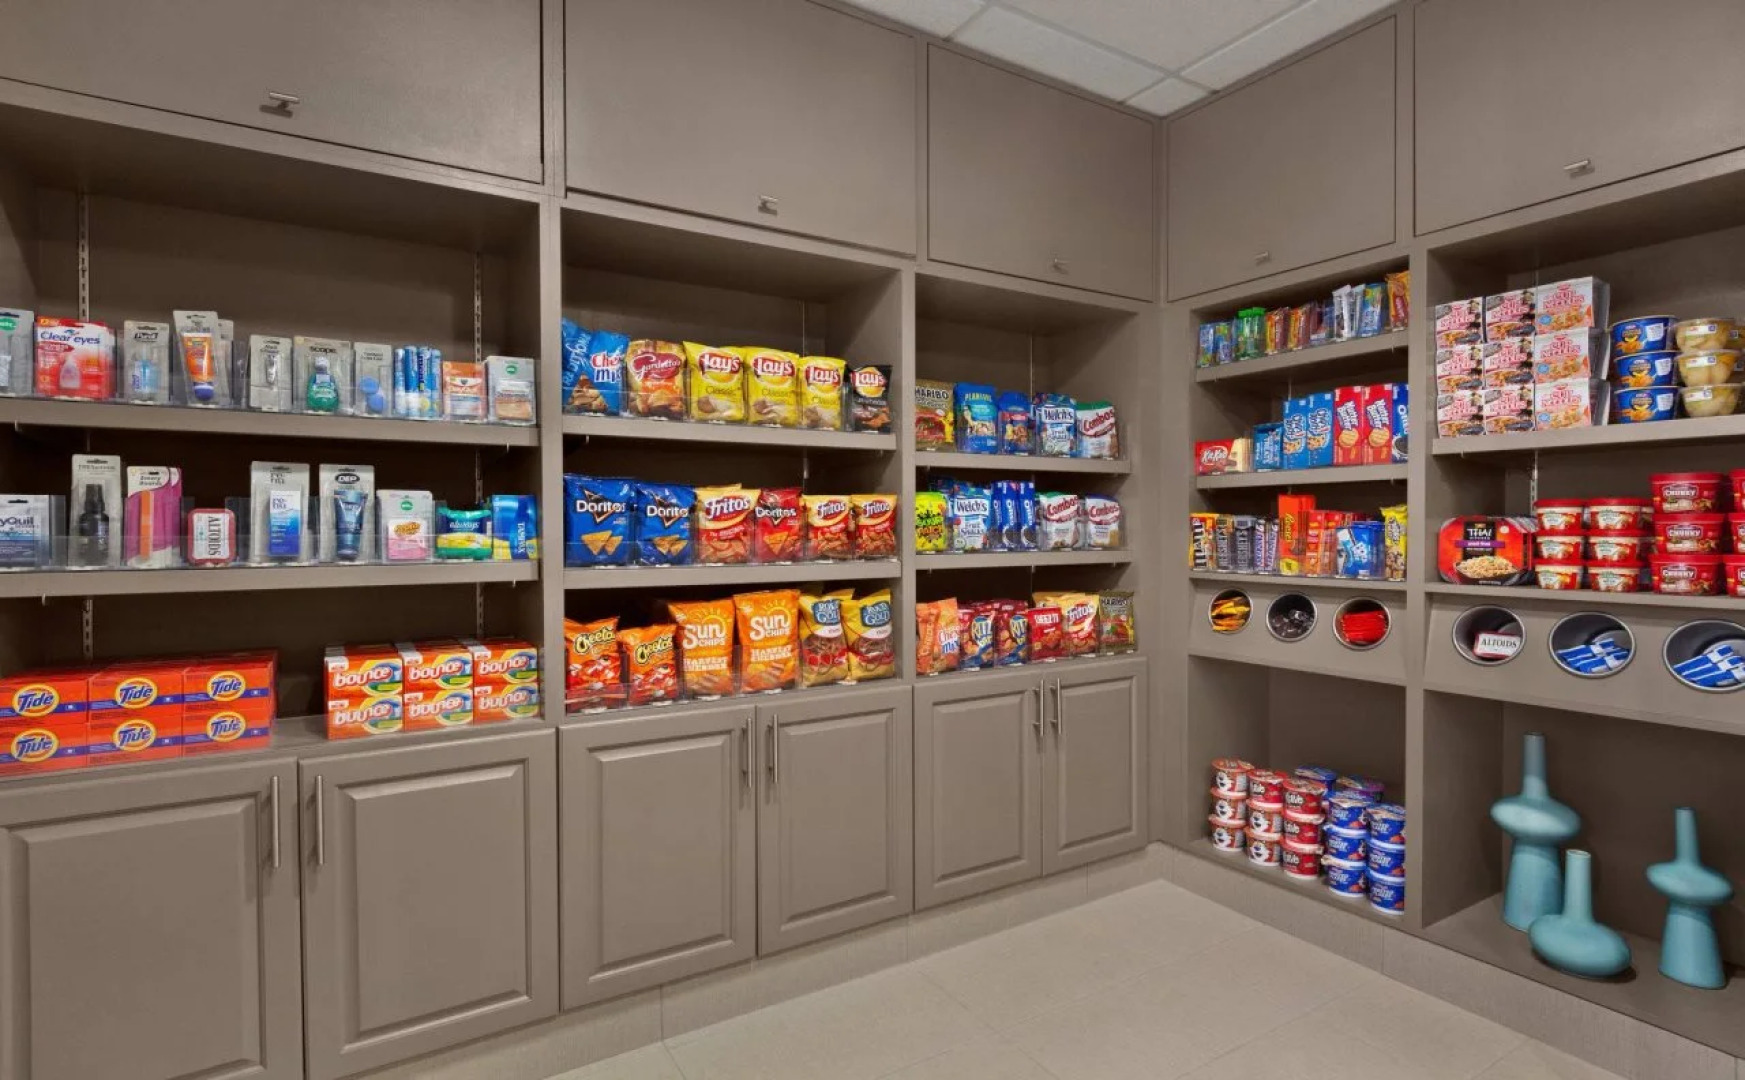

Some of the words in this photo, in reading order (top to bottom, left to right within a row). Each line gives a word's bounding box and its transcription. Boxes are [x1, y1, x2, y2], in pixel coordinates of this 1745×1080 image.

[41, 331, 71, 342] Clear
[74, 336, 101, 345] eyes
[705, 497, 751, 518] Fritos
[208, 516, 222, 556] ALTOIDS
[1481, 637, 1517, 649] ALTOIDS
[118, 686, 153, 705] Tide
[211, 679, 242, 697] Tide
[14, 693, 54, 713] Tide
